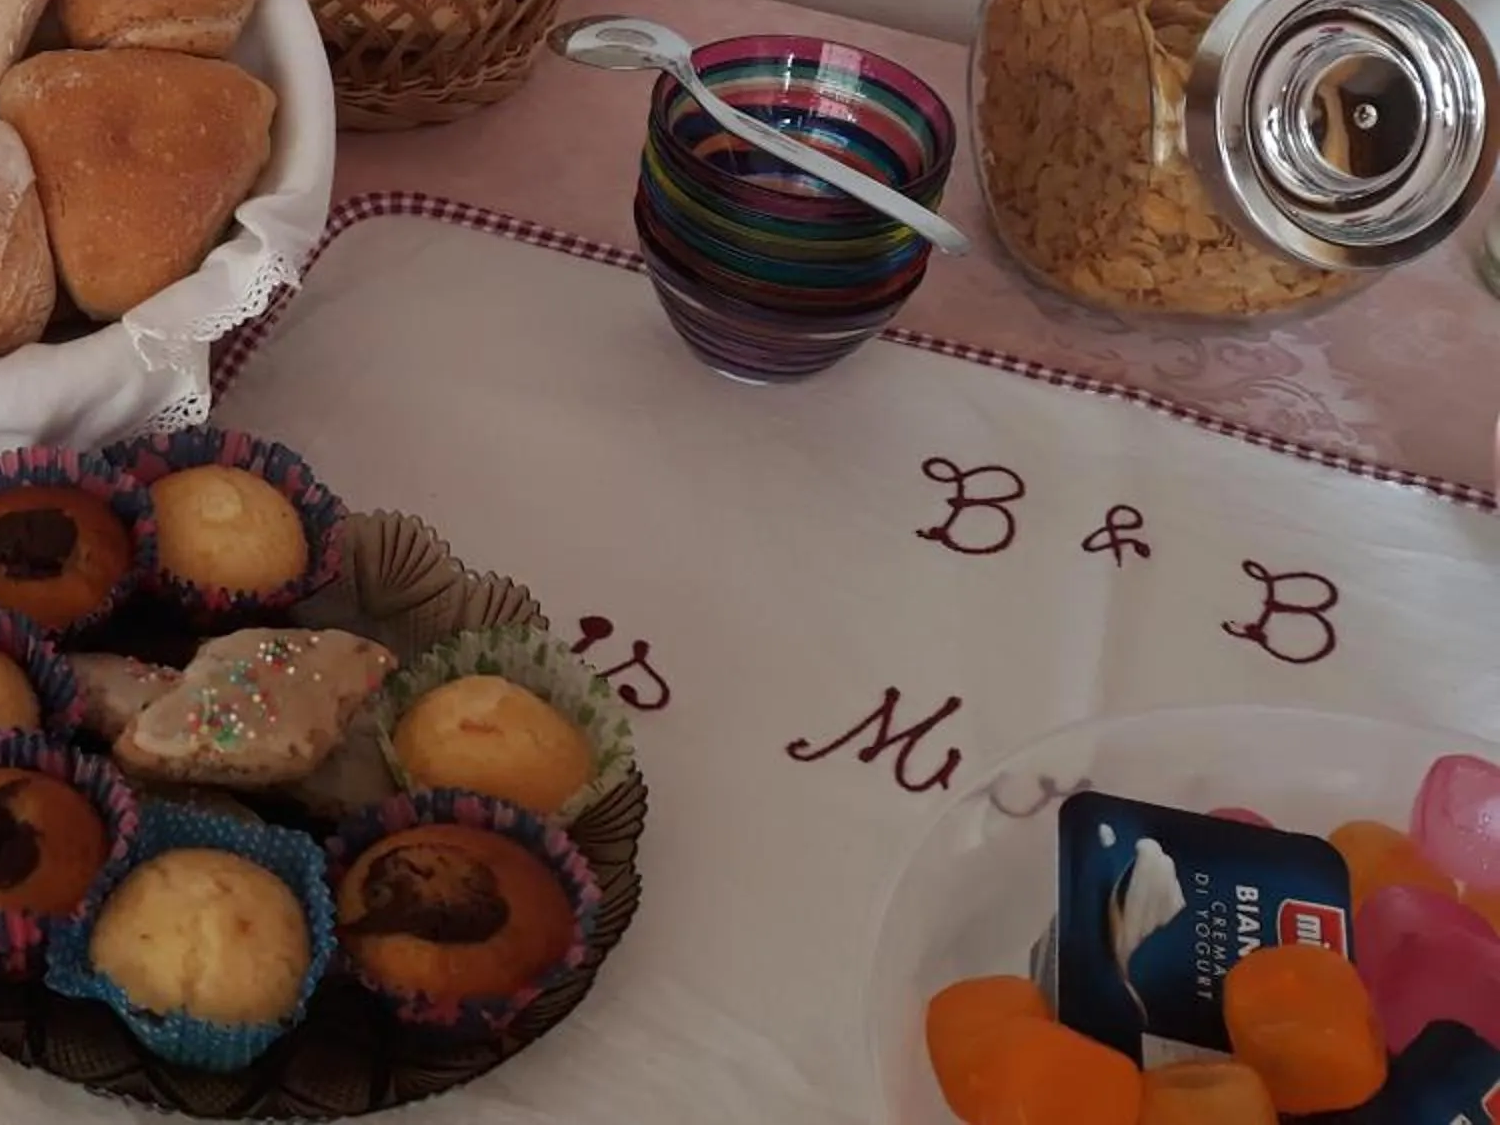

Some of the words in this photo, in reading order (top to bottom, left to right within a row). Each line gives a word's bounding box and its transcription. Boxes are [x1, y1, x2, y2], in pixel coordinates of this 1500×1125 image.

[916, 457, 1026, 555] B
[1081, 505, 1151, 567] &
[1220, 559, 1339, 664] B
[1195, 872, 1209, 895] DI
[1235, 884, 1262, 957] BIAN
[1195, 909, 1214, 1000] YOGURT
[1211, 900, 1228, 977] CREMA
